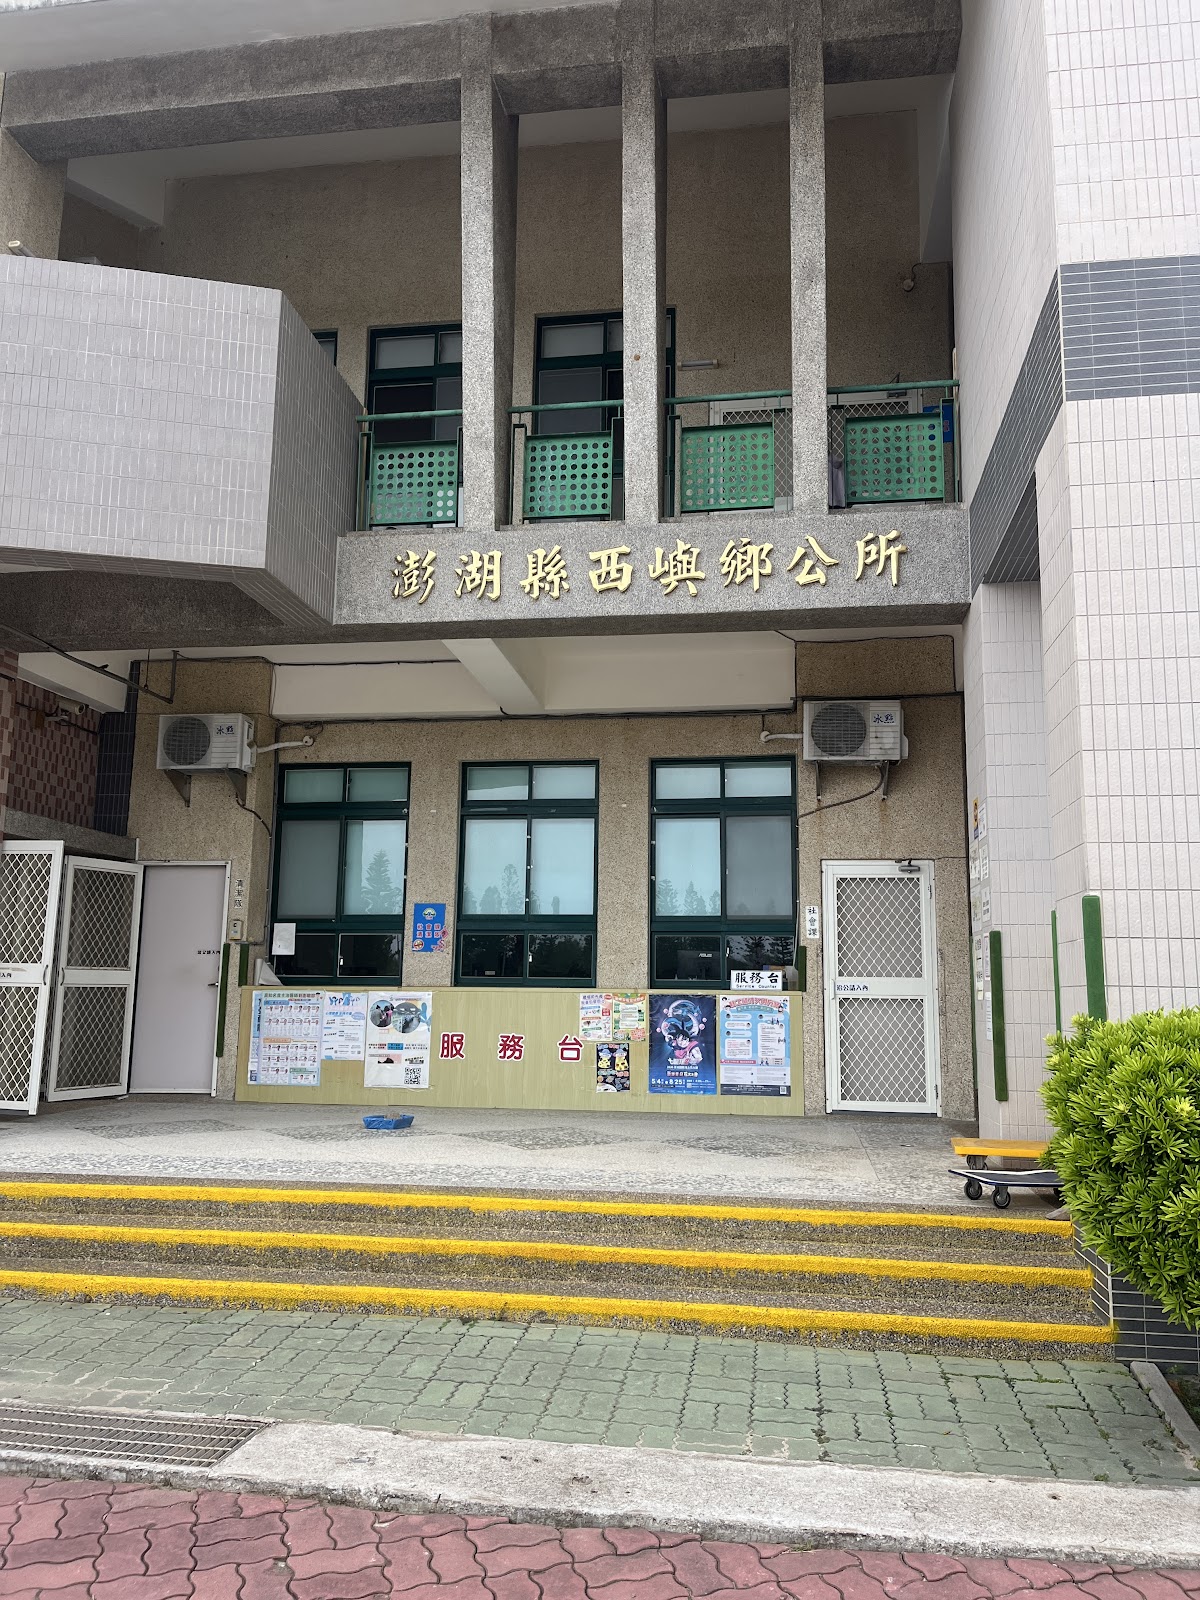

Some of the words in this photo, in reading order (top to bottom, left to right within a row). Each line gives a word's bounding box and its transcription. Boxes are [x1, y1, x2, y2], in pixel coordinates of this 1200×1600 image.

[390, 529, 907, 604] 澎湖縣西嶼鄉公所
[807, 906, 818, 937] 社會課
[735, 972, 779, 984] 服務台
[439, 1032, 584, 1061] 服務台
